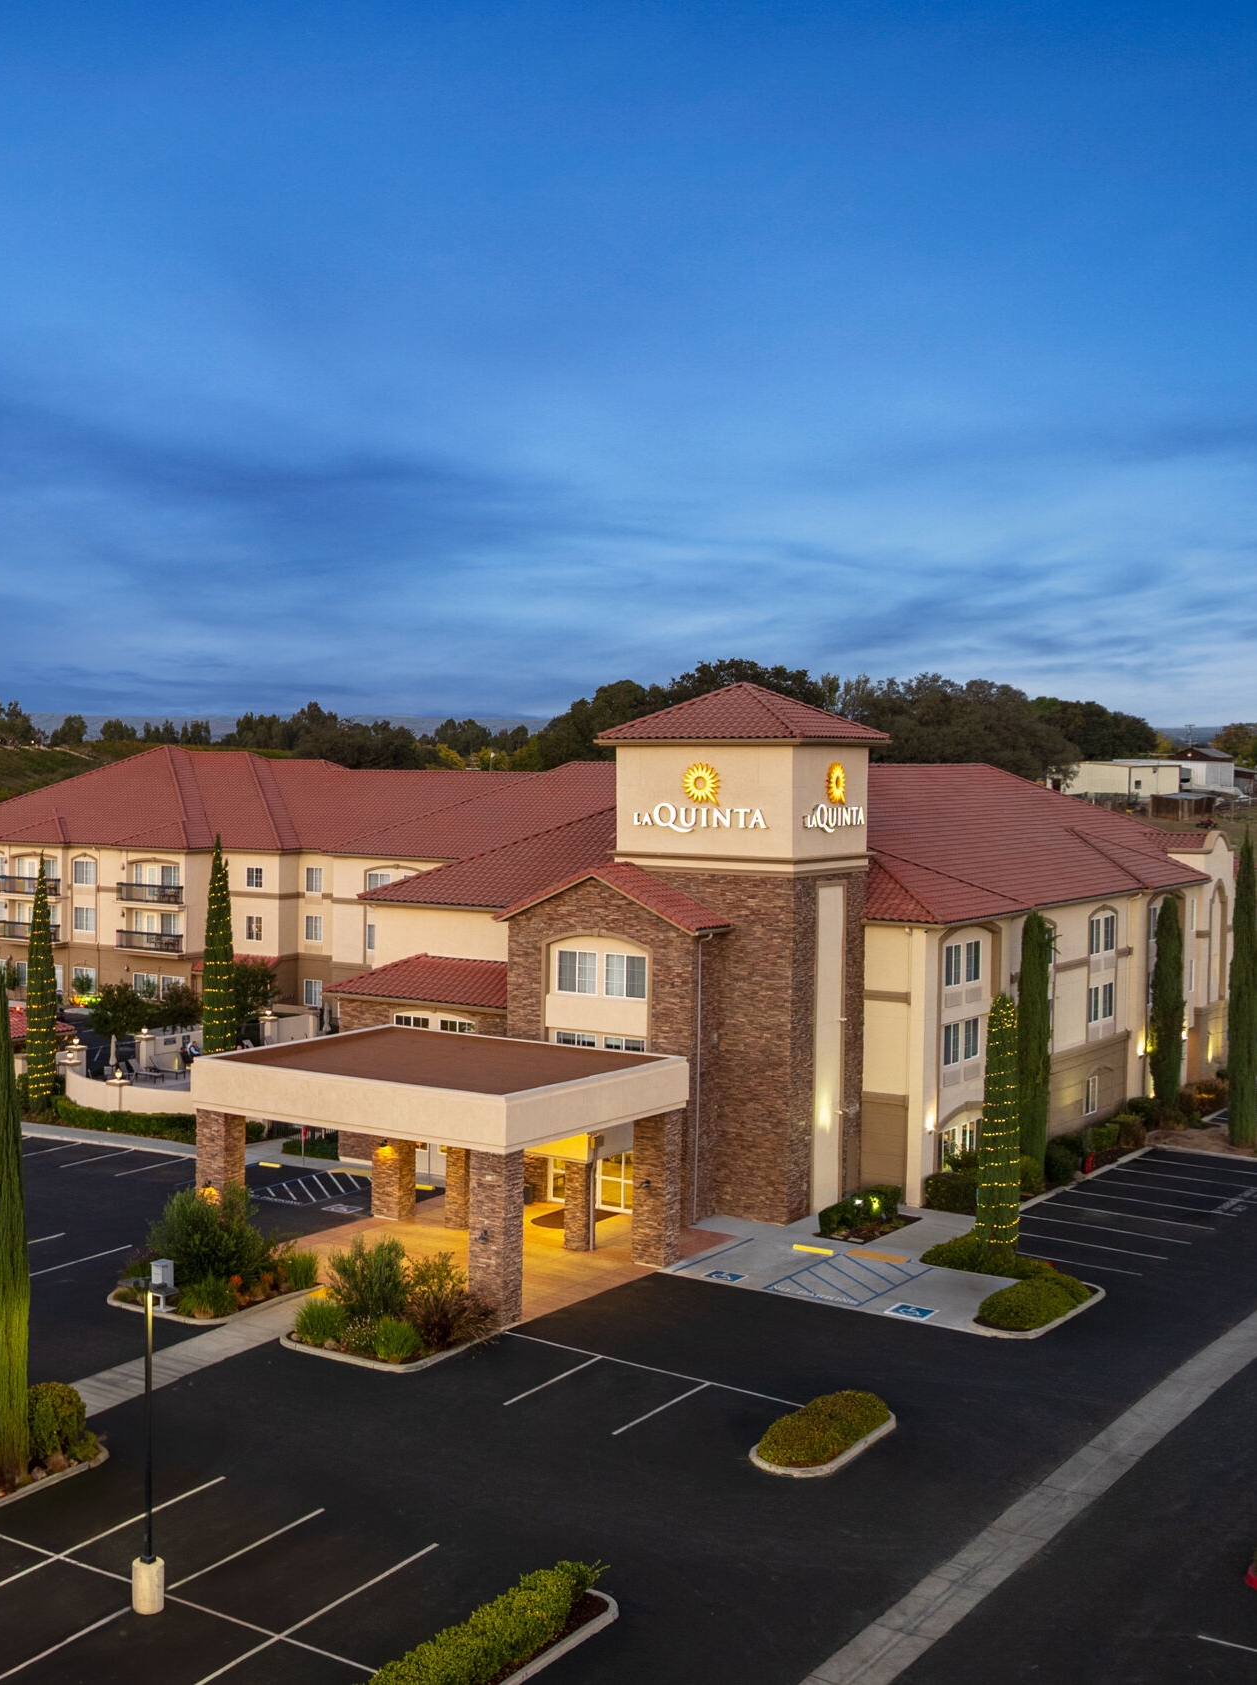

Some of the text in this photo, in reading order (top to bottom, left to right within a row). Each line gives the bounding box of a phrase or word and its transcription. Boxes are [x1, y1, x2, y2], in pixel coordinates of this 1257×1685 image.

[633, 802, 768, 833] LA QUINTA
[806, 803, 865, 833] LA QUINTA
